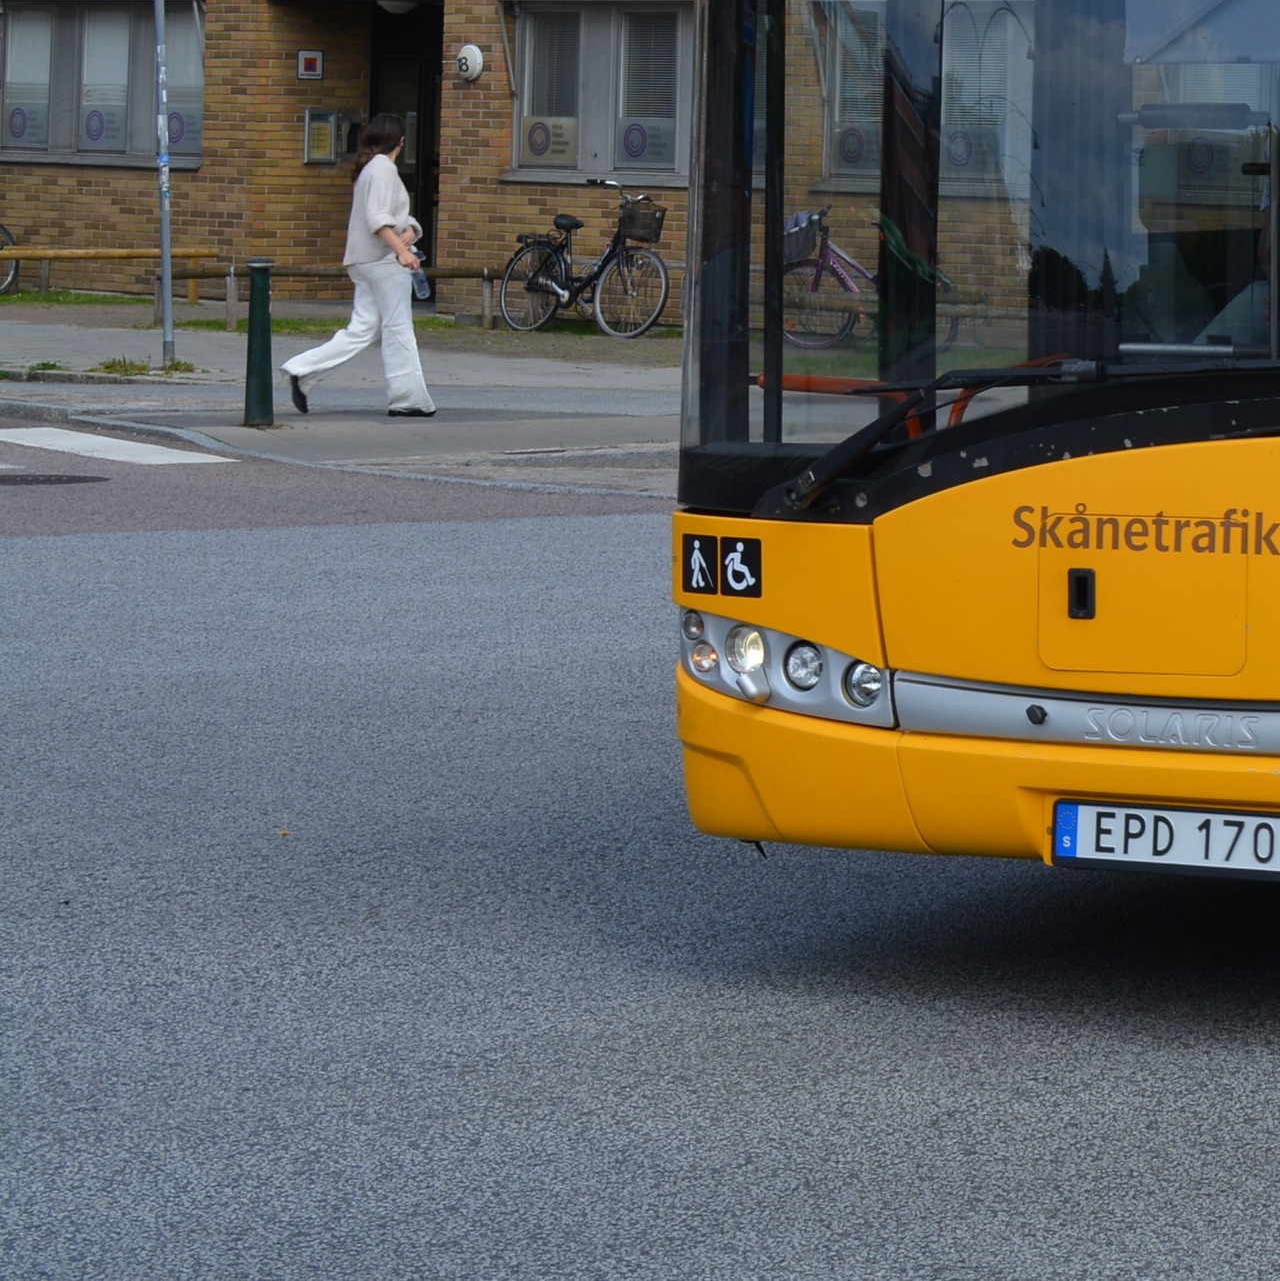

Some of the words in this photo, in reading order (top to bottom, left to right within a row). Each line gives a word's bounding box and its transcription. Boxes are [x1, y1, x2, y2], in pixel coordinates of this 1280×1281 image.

[457, 56, 470, 73] 18
[1084, 707, 1260, 749] SOLARIS
[1062, 836, 1072, 848] S
[1094, 810, 1175, 857] EPD
[1197, 818, 1275, 865] 170
